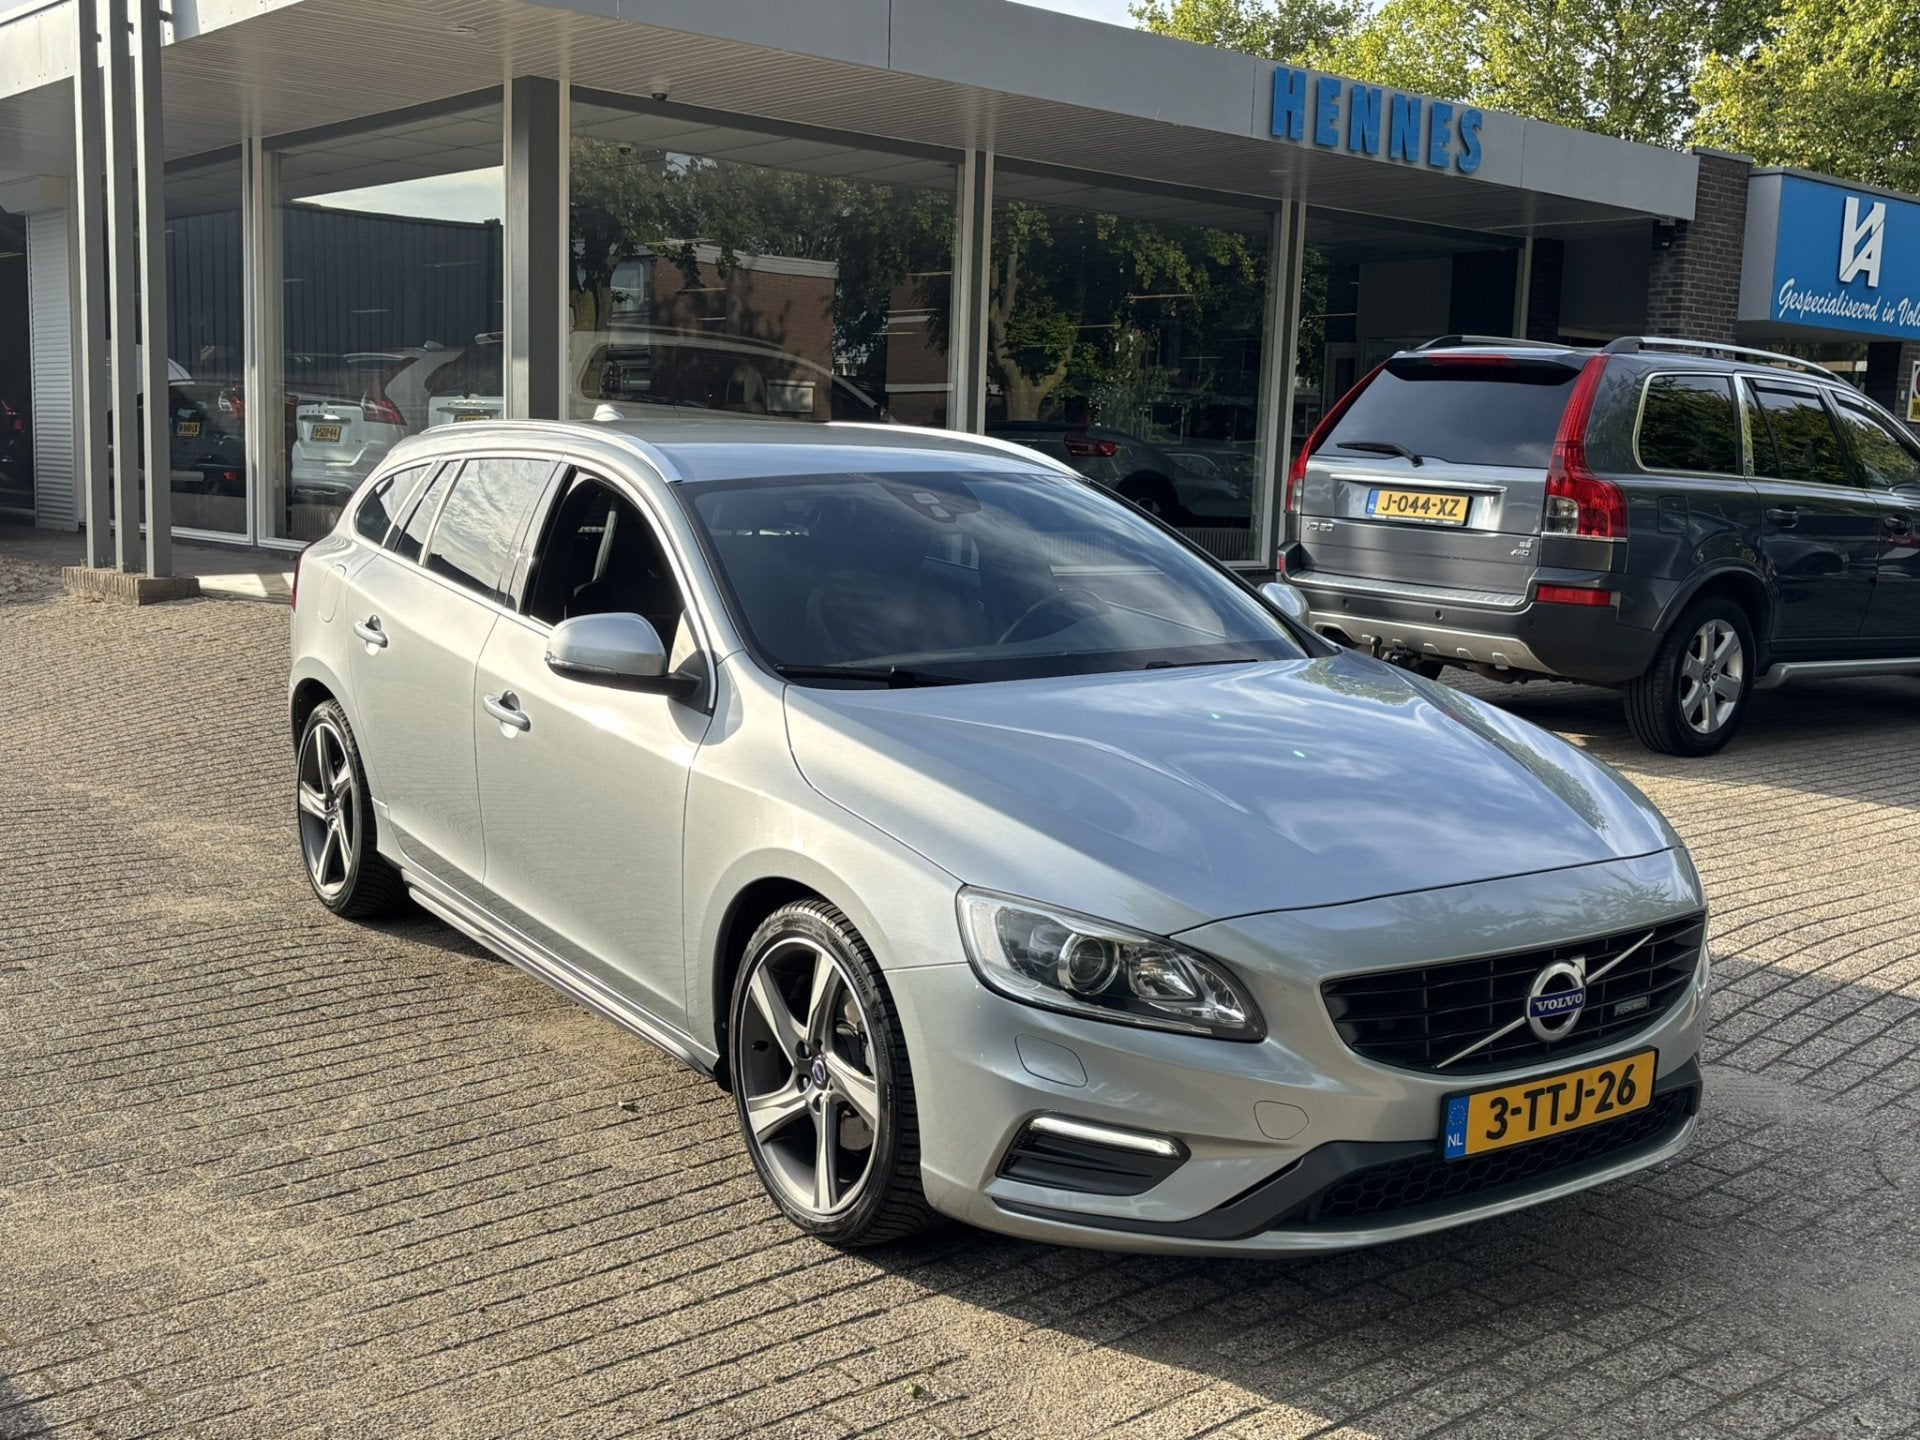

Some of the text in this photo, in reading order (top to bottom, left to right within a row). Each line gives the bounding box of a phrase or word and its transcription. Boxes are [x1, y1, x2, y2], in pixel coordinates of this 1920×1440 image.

[1272, 66, 1484, 174] HENNES
[1778, 278, 1920, 327] Gespecialiseerd in Vol
[1381, 493, 1461, 518] J-044-XZ
[1534, 993, 1584, 1012] VOLVO
[1485, 1063, 1637, 1141] 3-TTJ-26
[1447, 1134, 1463, 1148] NL
